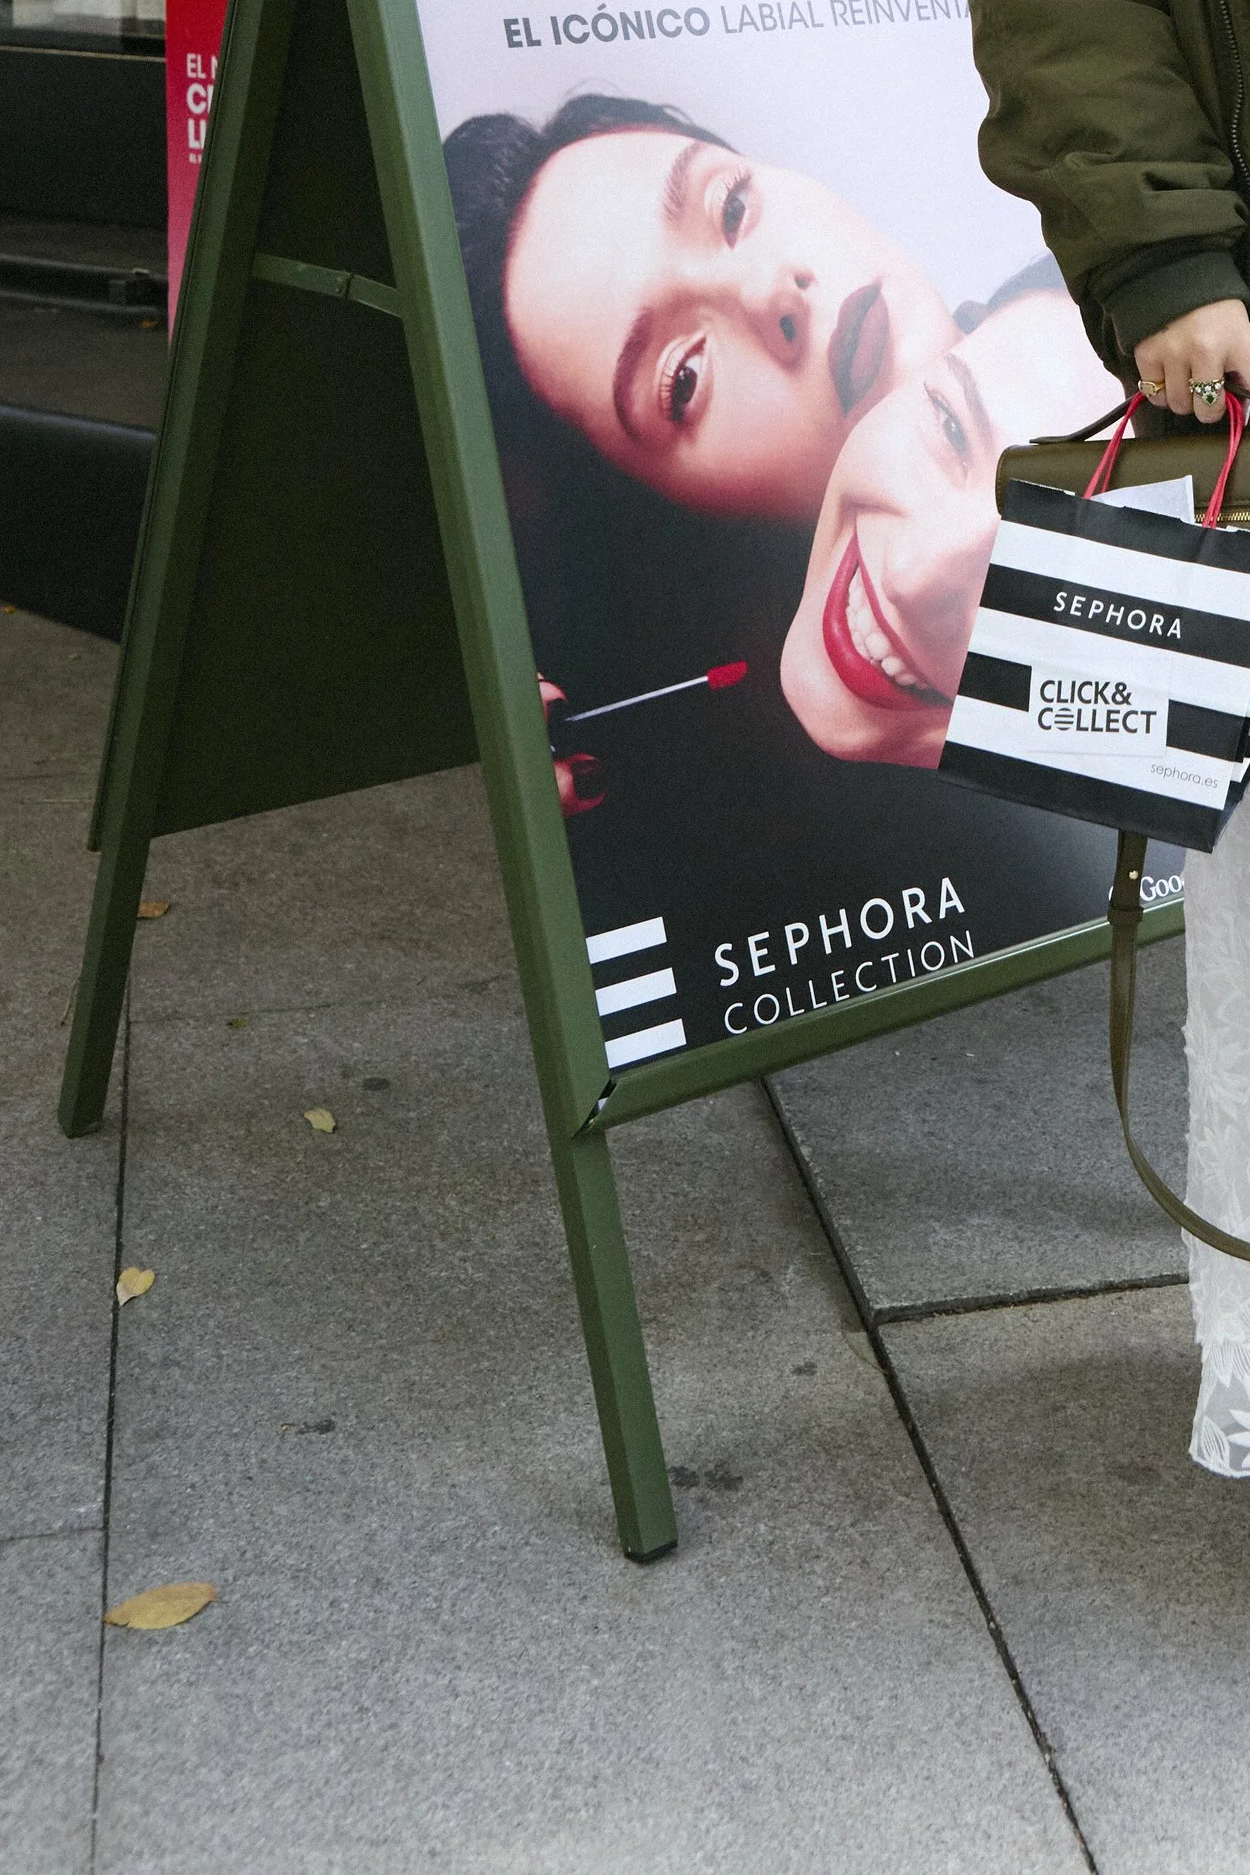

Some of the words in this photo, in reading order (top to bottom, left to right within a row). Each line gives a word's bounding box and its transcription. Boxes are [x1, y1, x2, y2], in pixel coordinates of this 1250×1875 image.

[503, 17, 541, 49] EL
[550, 3, 710, 46] ICÓNICO
[1053, 591, 1182, 639] SEPHORA
[1039, 679, 1133, 706] CLICK&
[1037, 707, 1157, 735] COLLECT
[1150, 762, 1219, 789] sephora.es
[714, 876, 966, 988] SEPHORA
[723, 929, 975, 1035] COLLECTION
